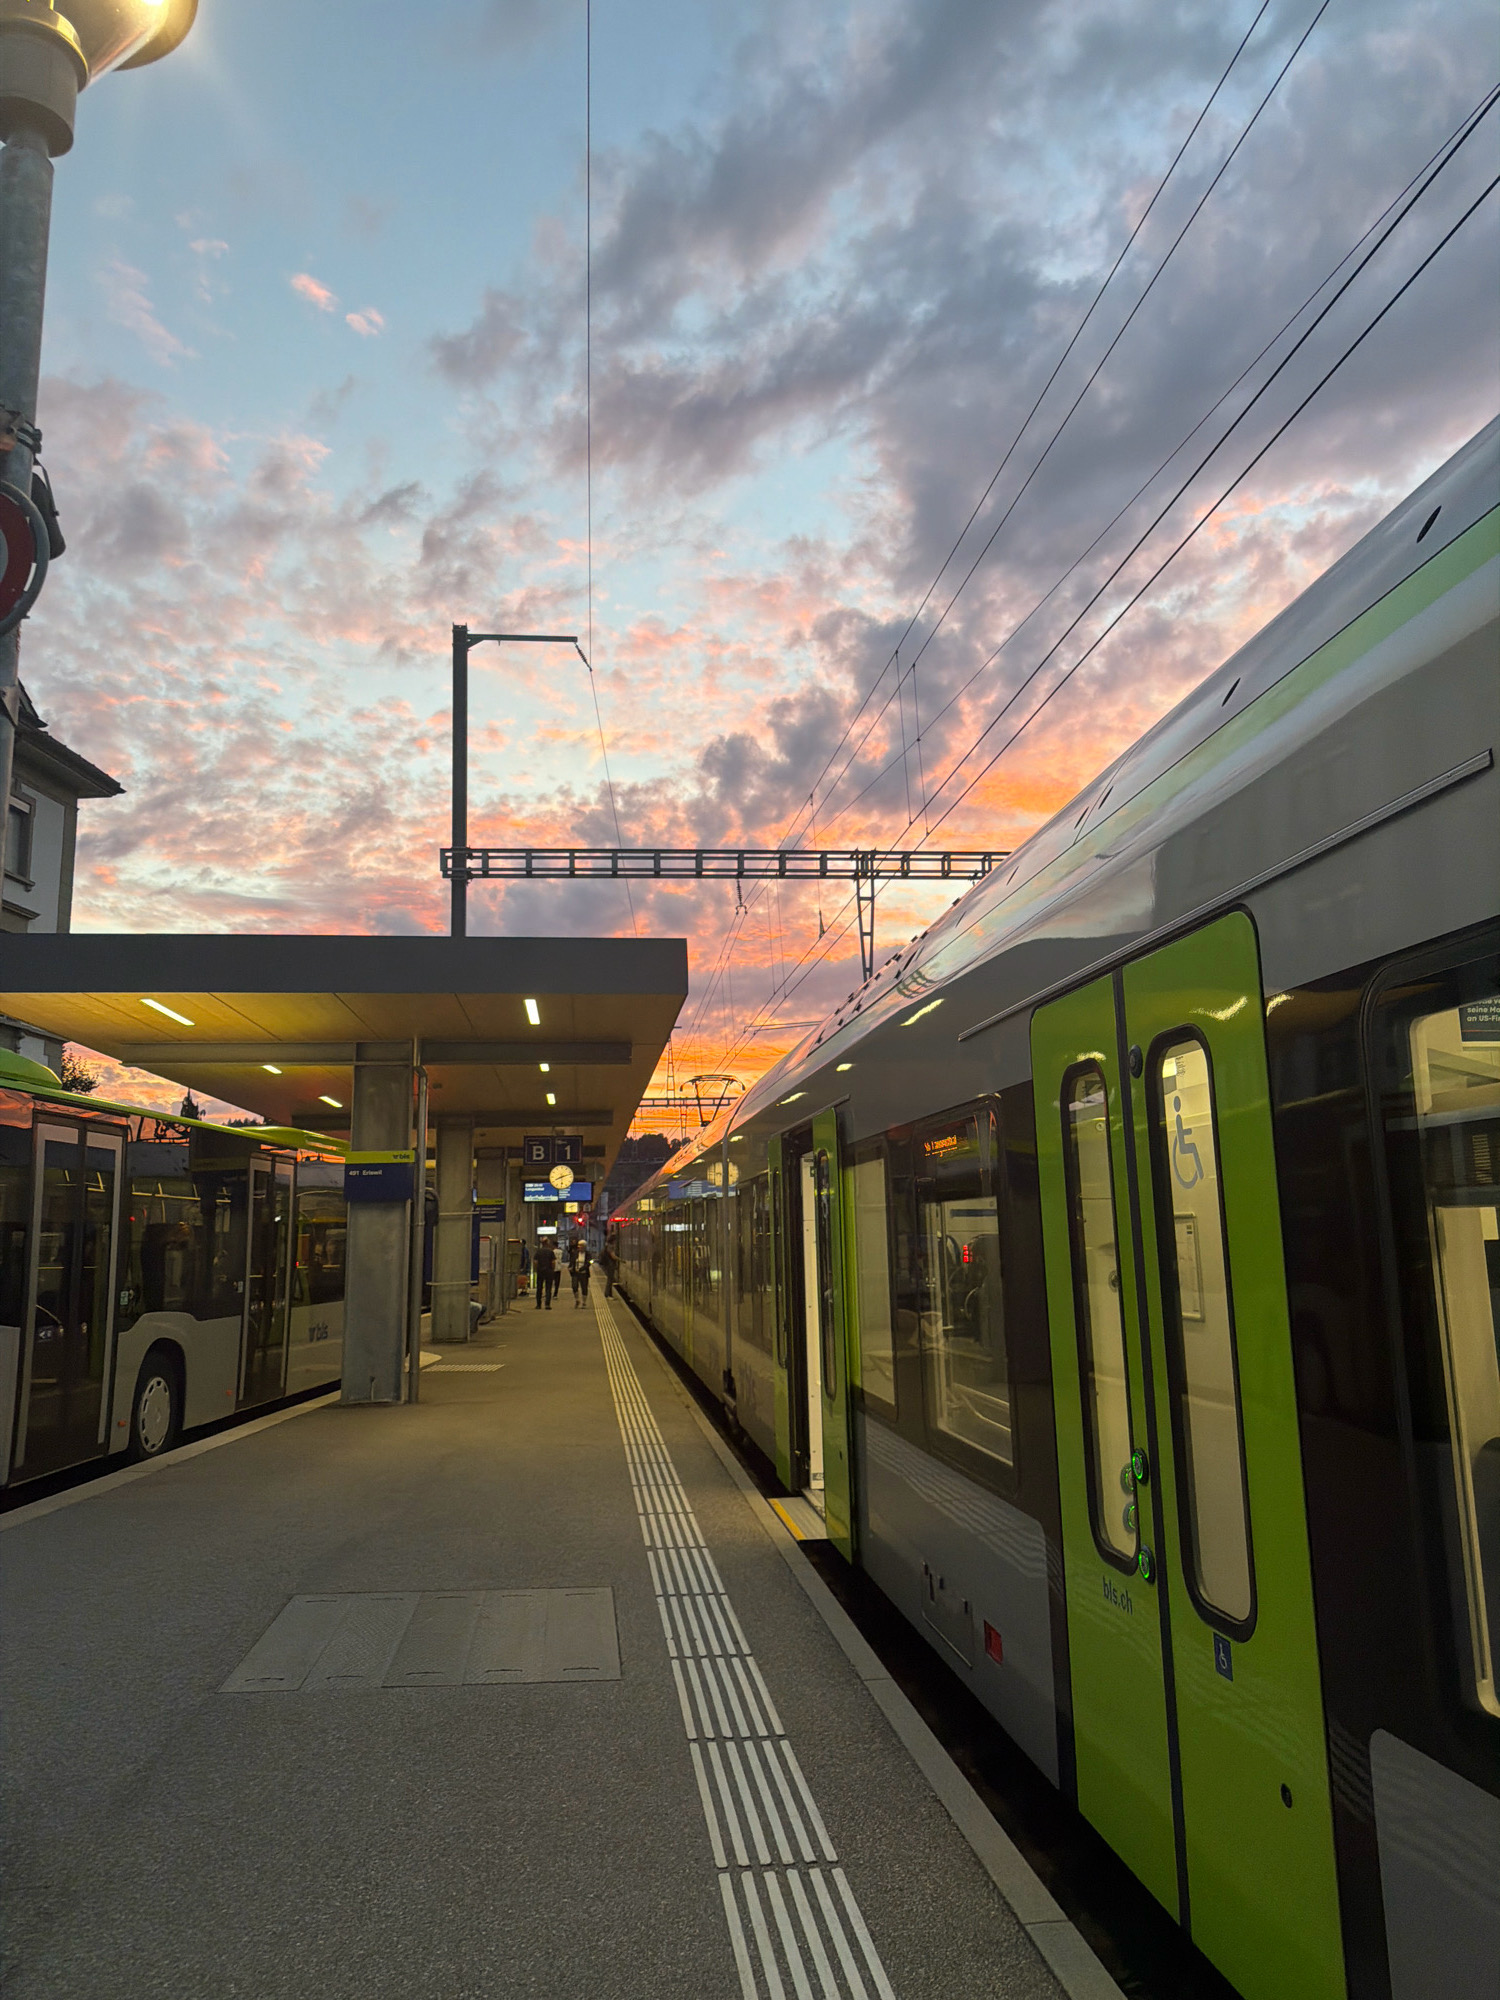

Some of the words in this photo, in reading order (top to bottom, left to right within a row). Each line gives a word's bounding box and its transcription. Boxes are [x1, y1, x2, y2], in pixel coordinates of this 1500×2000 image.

[1467, 1005, 1488, 1013] seine
[532, 1145, 545, 1161] B
[564, 1144, 571, 1160] 1
[1102, 1575, 1133, 1616] bls.ch
